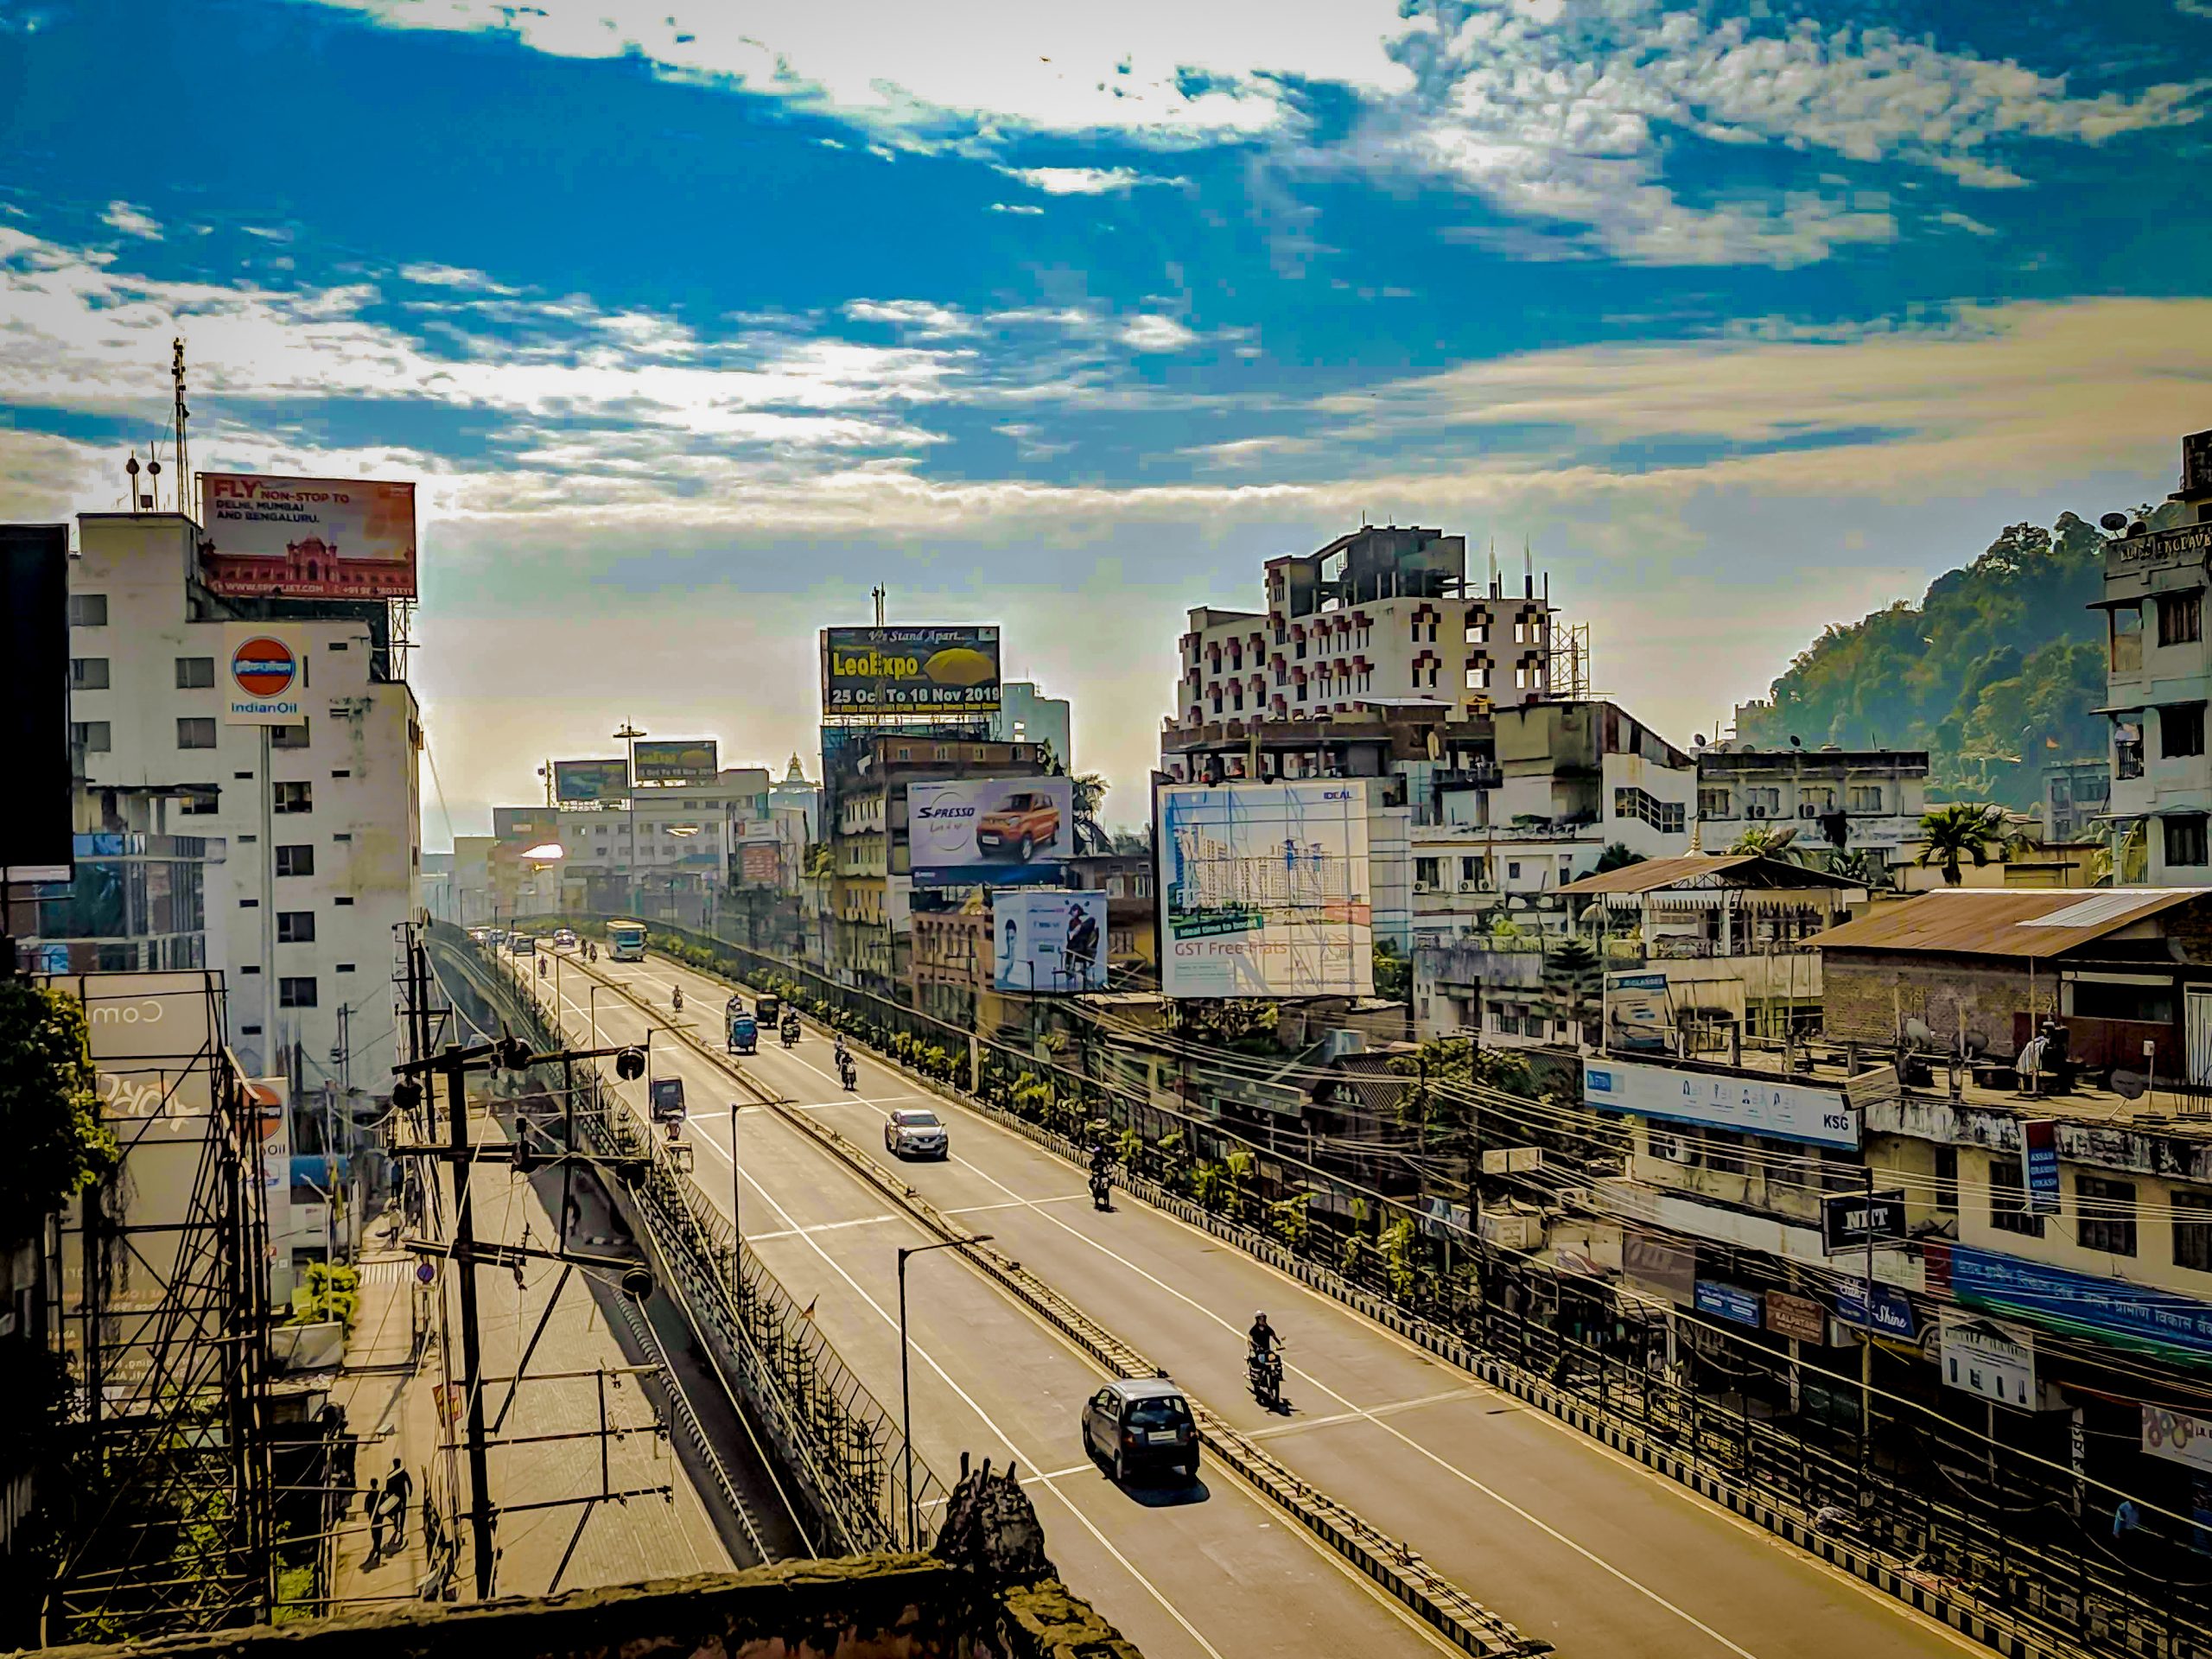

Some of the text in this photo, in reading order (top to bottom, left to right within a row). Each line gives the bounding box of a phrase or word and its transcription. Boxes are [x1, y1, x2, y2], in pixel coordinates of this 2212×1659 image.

[214, 480, 349, 504] FLY NON-STOP TO
[257, 501, 303, 512] MUMBAI
[217, 511, 242, 519] AND
[889, 629, 925, 642] Stand
[833, 652, 918, 680] LeoExpo
[832, 690, 852, 704] 25
[855, 689, 882, 704] Oc
[887, 689, 906, 703] To
[932, 688, 962, 702] Nov
[231, 702, 297, 714] IndianOil
[1175, 942, 1203, 956] GST
[1209, 941, 1243, 955] Free
[1823, 1114, 1848, 1131] KSG
[1874, 1305, 1907, 1329] Shine
